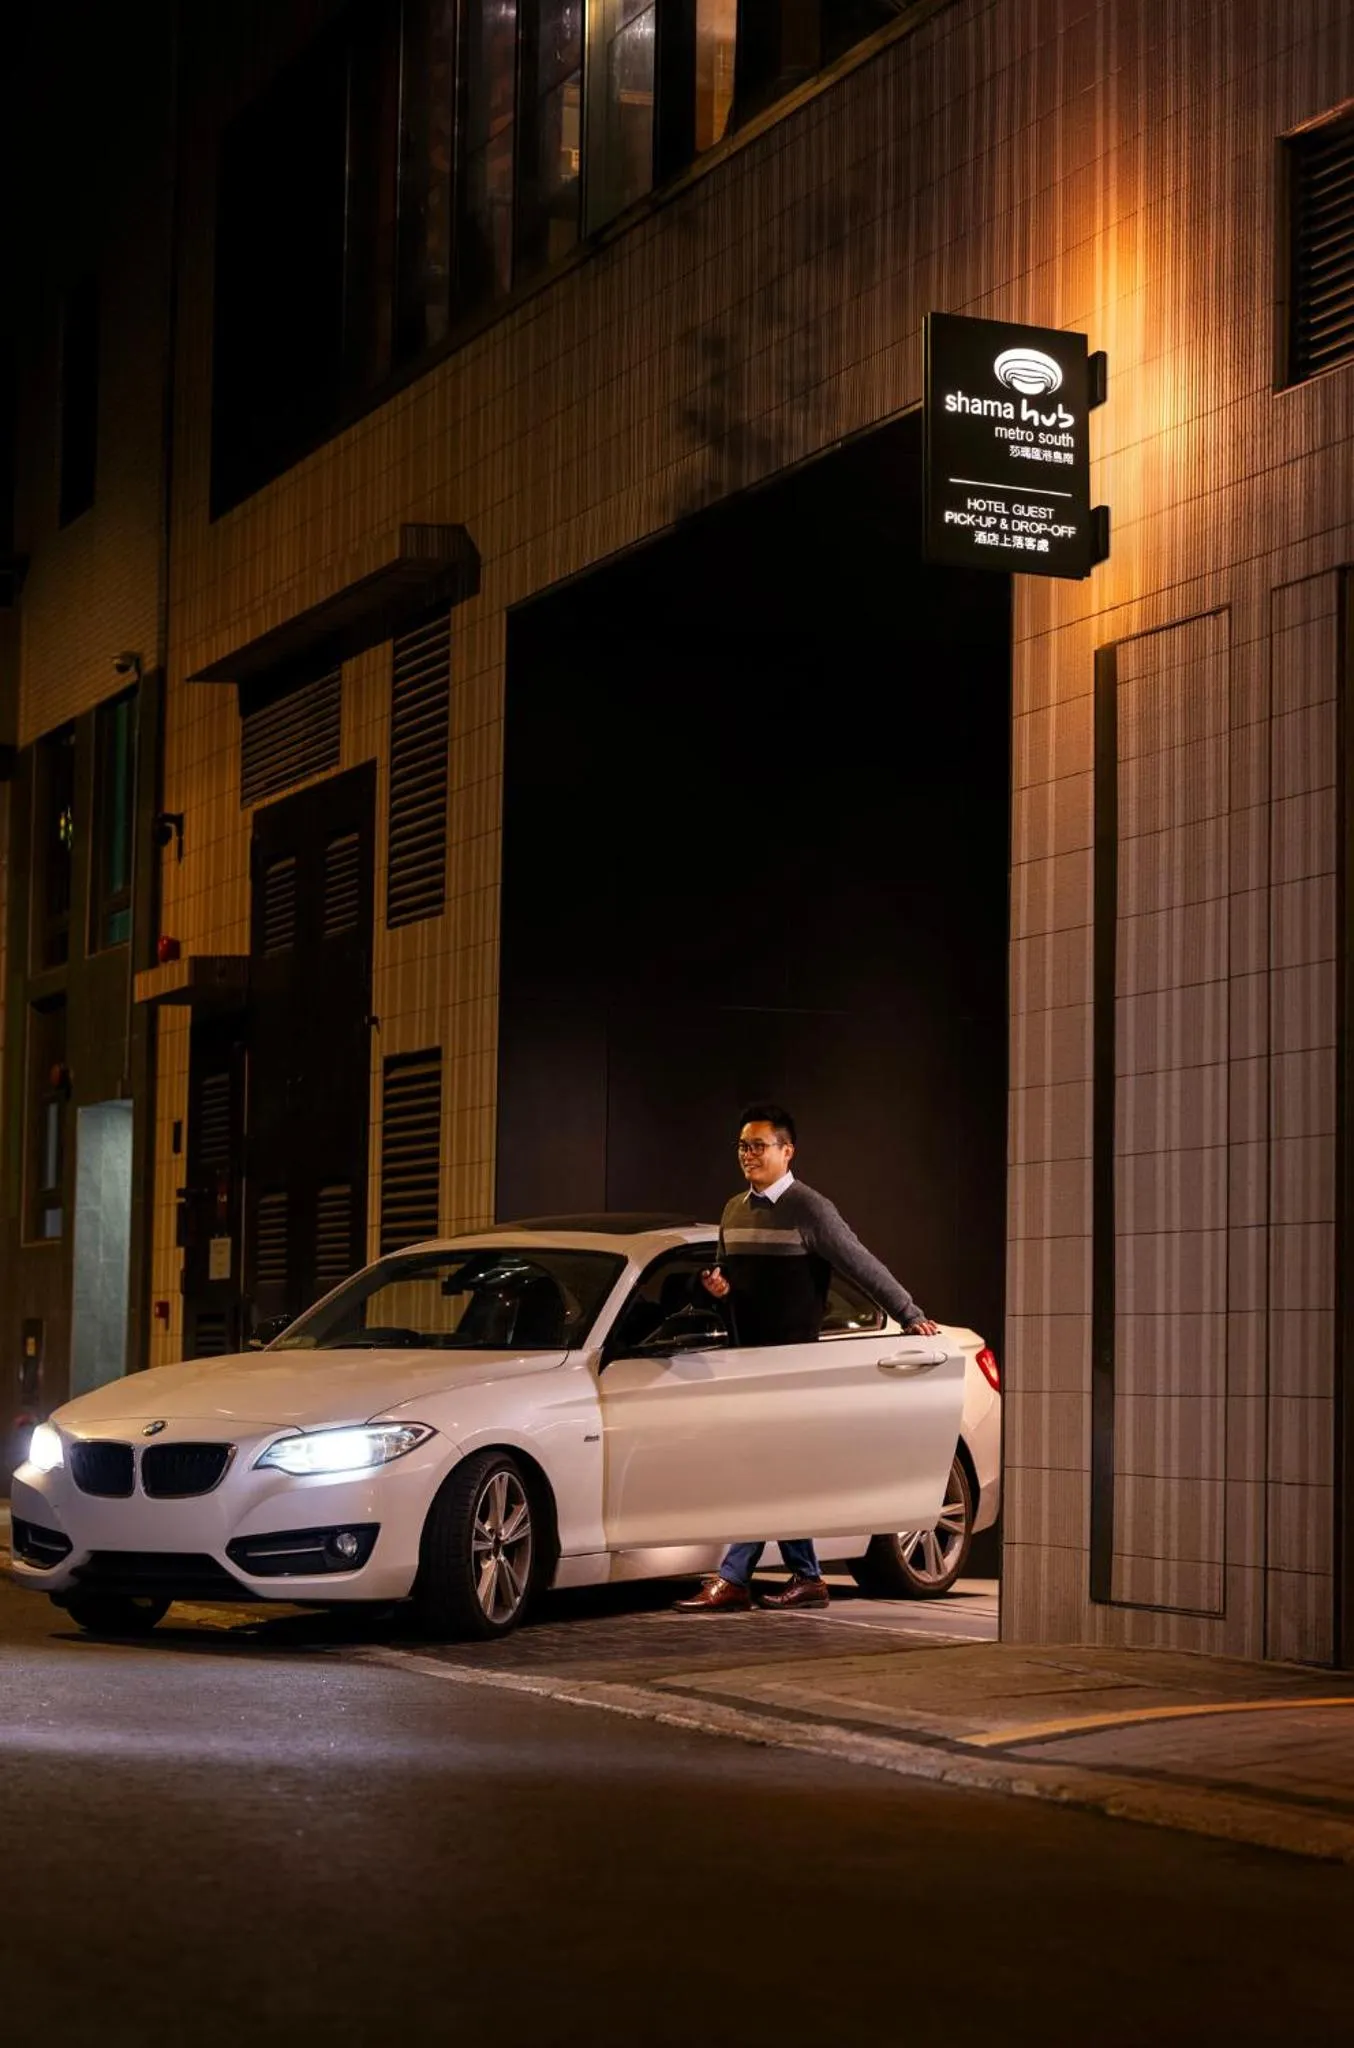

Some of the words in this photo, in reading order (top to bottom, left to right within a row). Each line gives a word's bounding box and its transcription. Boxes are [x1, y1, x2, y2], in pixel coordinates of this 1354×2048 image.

[944, 391, 1014, 419] shama
[1020, 398, 1075, 428] hub
[994, 425, 1034, 443] metro
[1038, 429, 1074, 448] south
[967, 498, 1010, 515] HOTEL
[1012, 503, 1055, 519] GUEST
[944, 511, 997, 529] PICK-UP
[999, 518, 1009, 531] &
[1011, 520, 1077, 539] DROP-OFF
